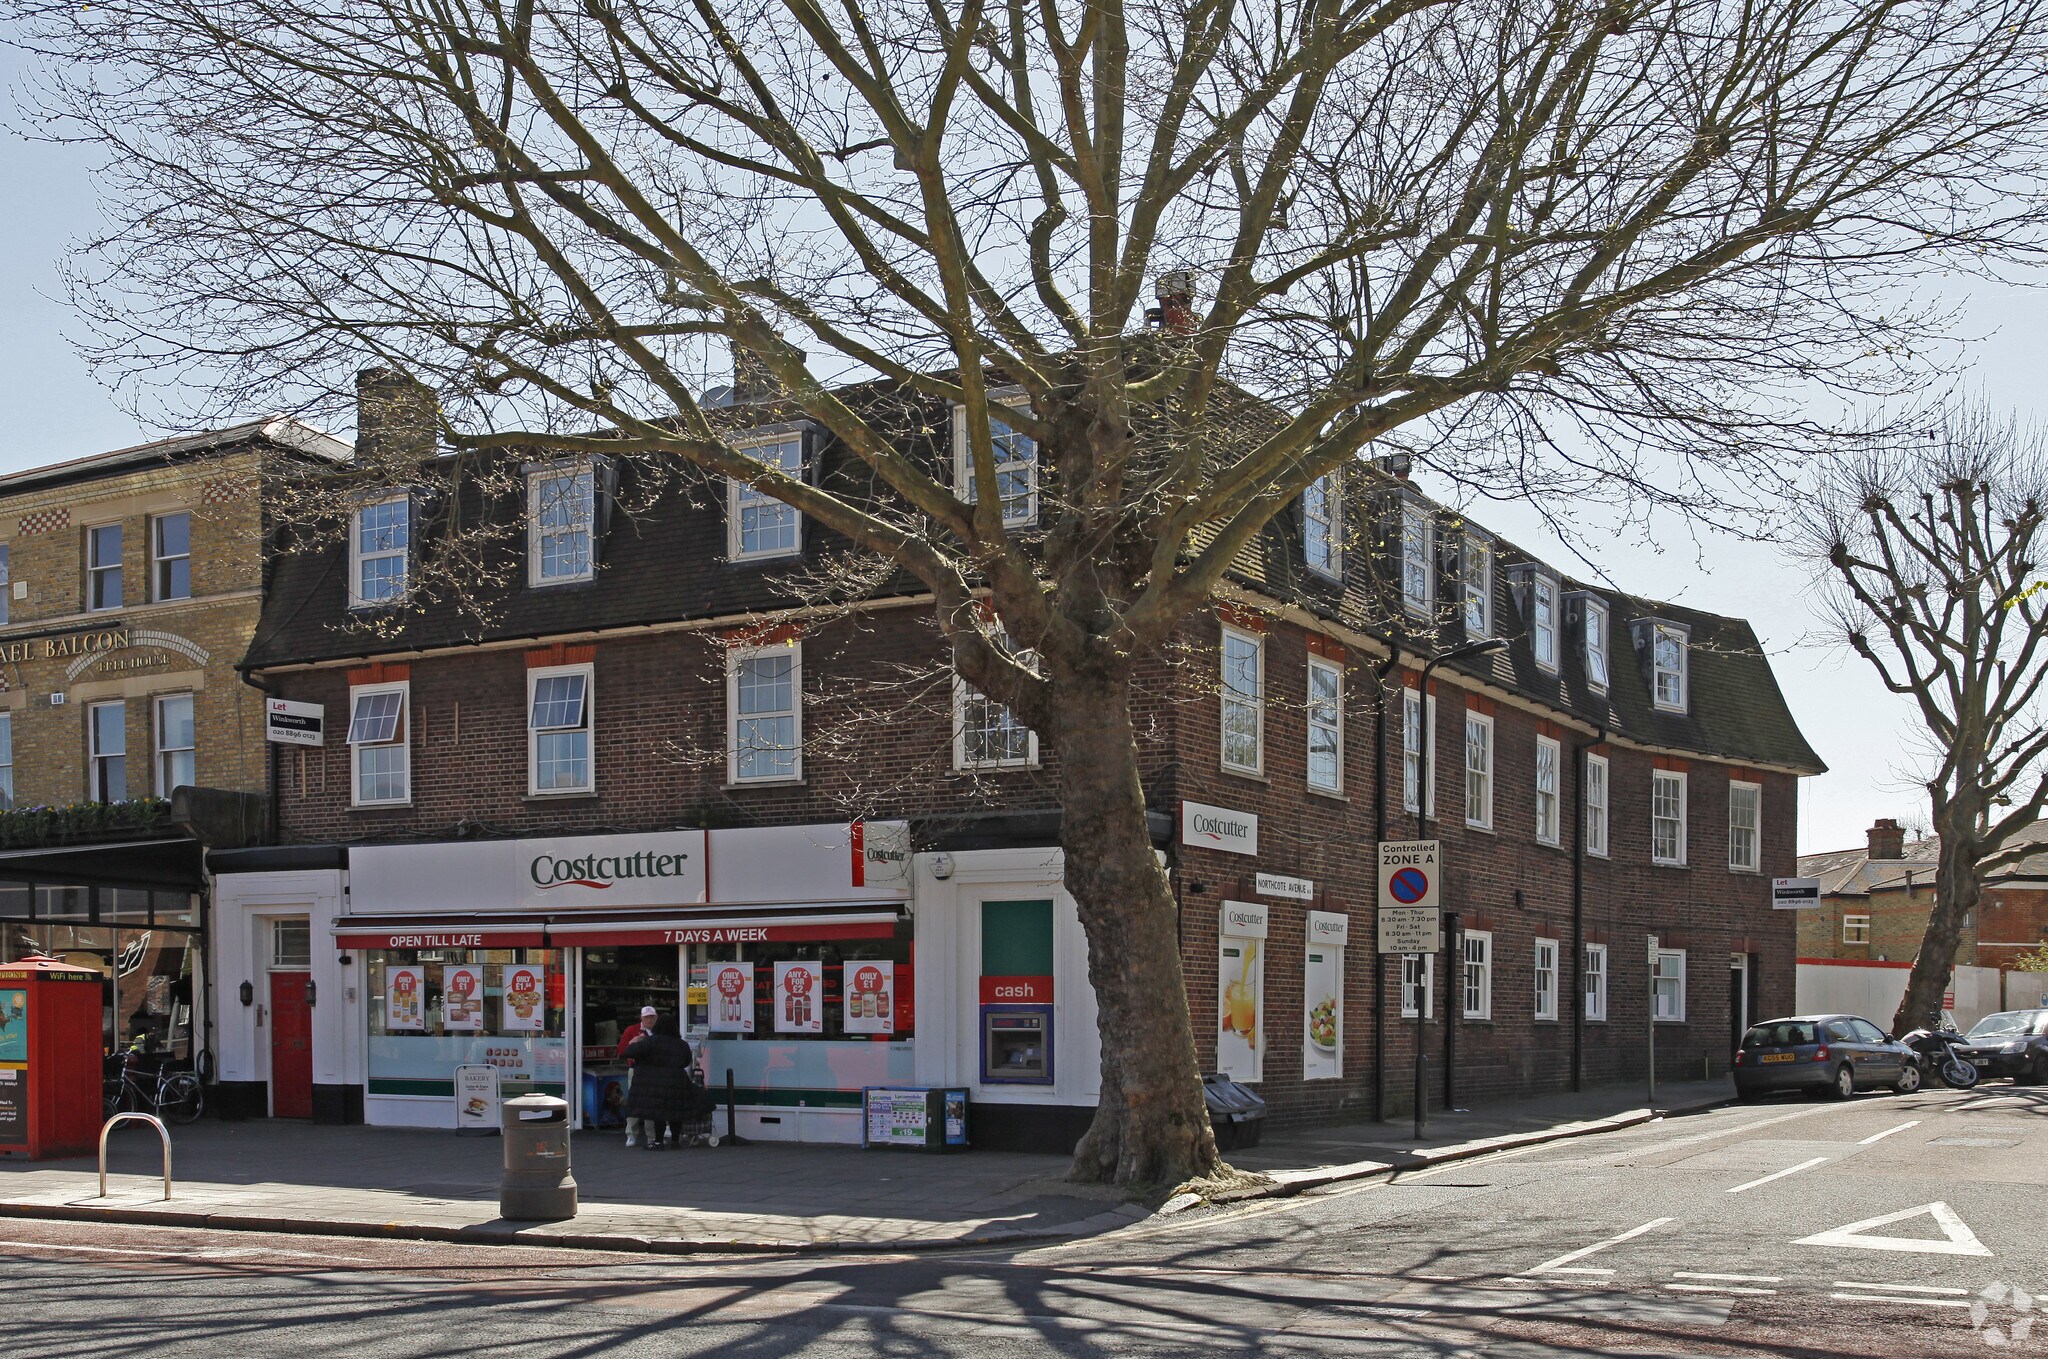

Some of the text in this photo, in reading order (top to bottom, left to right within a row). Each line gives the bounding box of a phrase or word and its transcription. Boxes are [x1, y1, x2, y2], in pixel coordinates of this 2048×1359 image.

[46, 629, 130, 658] BALCON
[100, 653, 170, 672] FREE HOUSE
[273, 701, 286, 711] Let
[272, 714, 306, 725] Winkworth
[286, 730, 301, 738] 8896
[1193, 814, 1249, 838] Costcutter
[1383, 844, 1435, 852] Controlled
[867, 847, 905, 861] Costcutter
[1383, 854, 1434, 864] ZONE A
[531, 851, 688, 885] Costcutter
[1258, 879, 1286, 891] NORTHCOTE
[1288, 883, 1306, 894] AVENUE
[1229, 911, 1263, 925] Costcutter
[1314, 920, 1344, 932] Costcutter
[390, 934, 482, 947] OPEN TILL LATE
[664, 928, 768, 943] 7 DAYS A WEEK
[49, 972, 83, 980] WiFi here
[456, 975, 470, 983] ONLY
[722, 971, 740, 979] ONLY
[788, 971, 801, 979] ANY
[860, 972, 877, 980] ONLY
[401, 982, 409, 990] £1
[459, 982, 467, 991] £1
[793, 985, 803, 994] £2
[863, 980, 874, 989] £1
[995, 983, 1034, 997] cash
